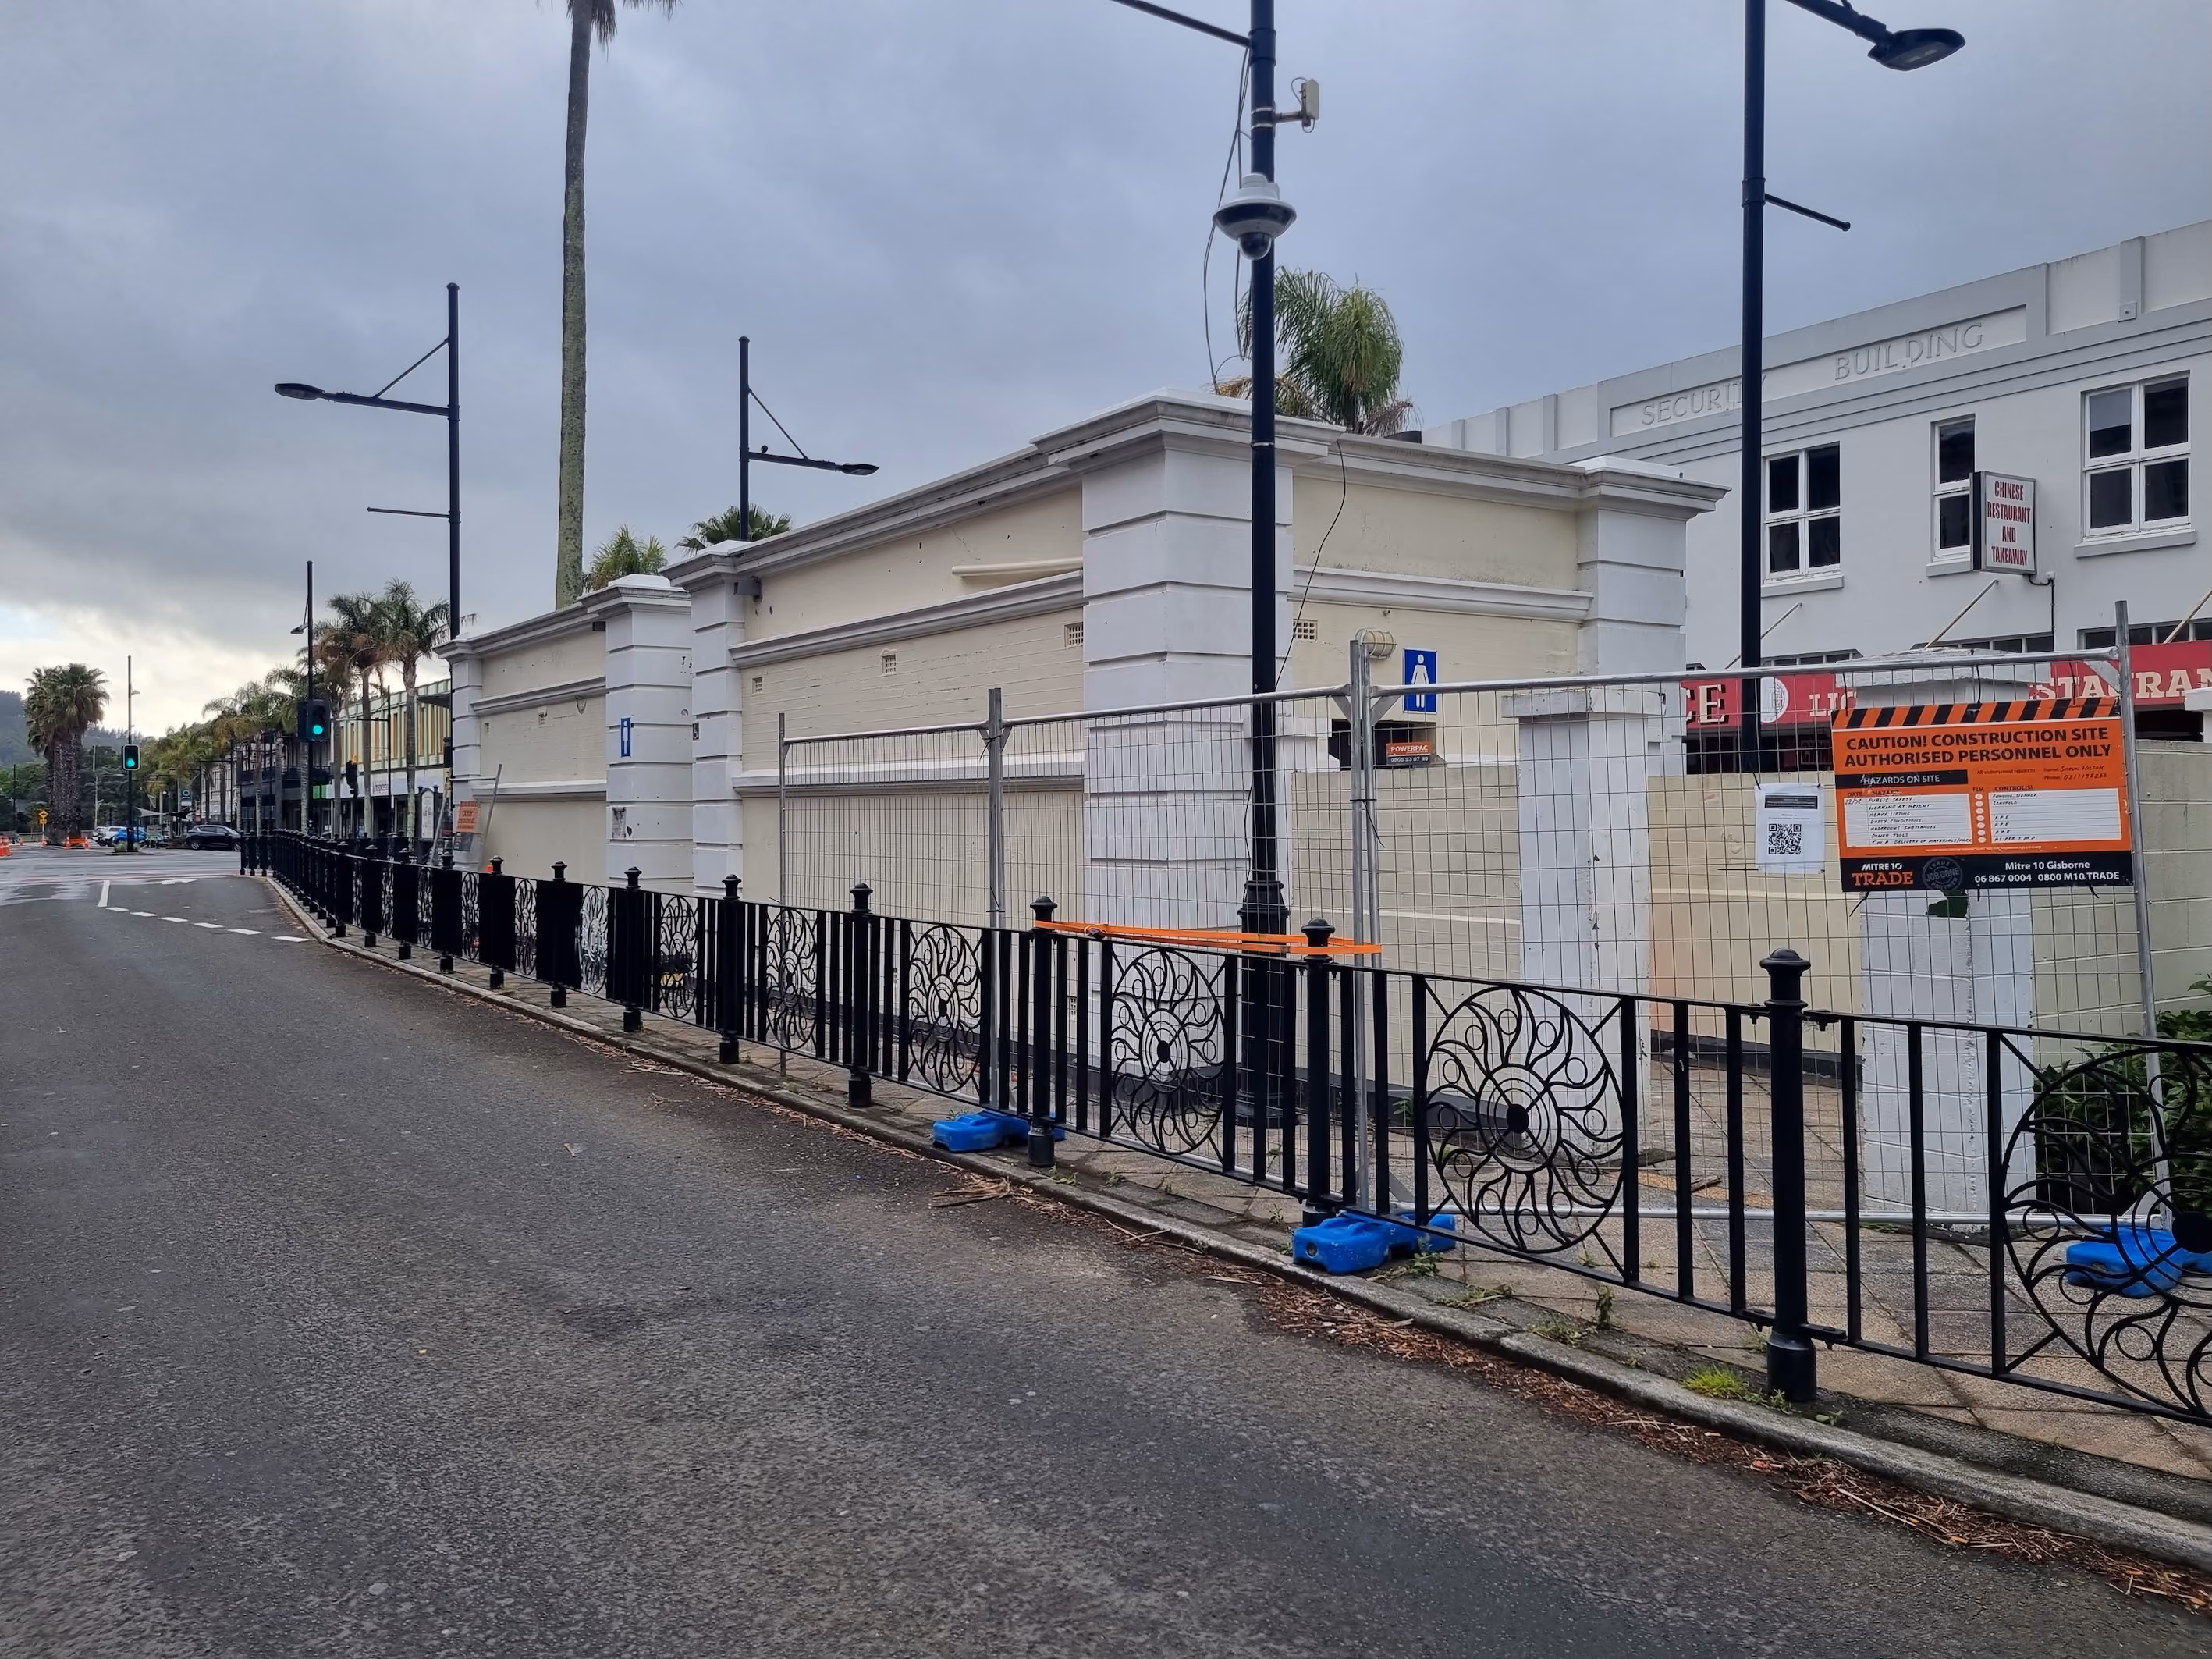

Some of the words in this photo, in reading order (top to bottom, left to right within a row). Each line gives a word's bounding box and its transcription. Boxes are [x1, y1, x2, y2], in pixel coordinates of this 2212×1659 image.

[1641, 374, 1766, 426] SECURIT
[1835, 323, 1983, 380] BUILDING
[1994, 481, 2024, 501] CHINESE
[1987, 502, 2031, 524] RESTAURANT
[2001, 525, 2016, 542] AND
[1991, 546, 2028, 566] TAKEAWAY
[1846, 735, 1927, 750] CAUTION!
[1931, 730, 2067, 747] CONSTRUCTION
[2072, 727, 2108, 741] SITE
[1845, 751, 1954, 767] AUTHORISED
[1958, 747, 2061, 763] PERSONNEL
[2066, 744, 2111, 758] ONLY
[1862, 776, 1904, 785] HAZARDS
[2005, 861, 2031, 870] Mitre
[2047, 861, 2090, 869] Gisborne
[1852, 872, 1914, 886] TRADE
[1926, 872, 1940, 882] JOB
[1940, 868, 1960, 878] DONE
[1988, 874, 2006, 883] 867
[2086, 872, 2119, 880] TRADE
